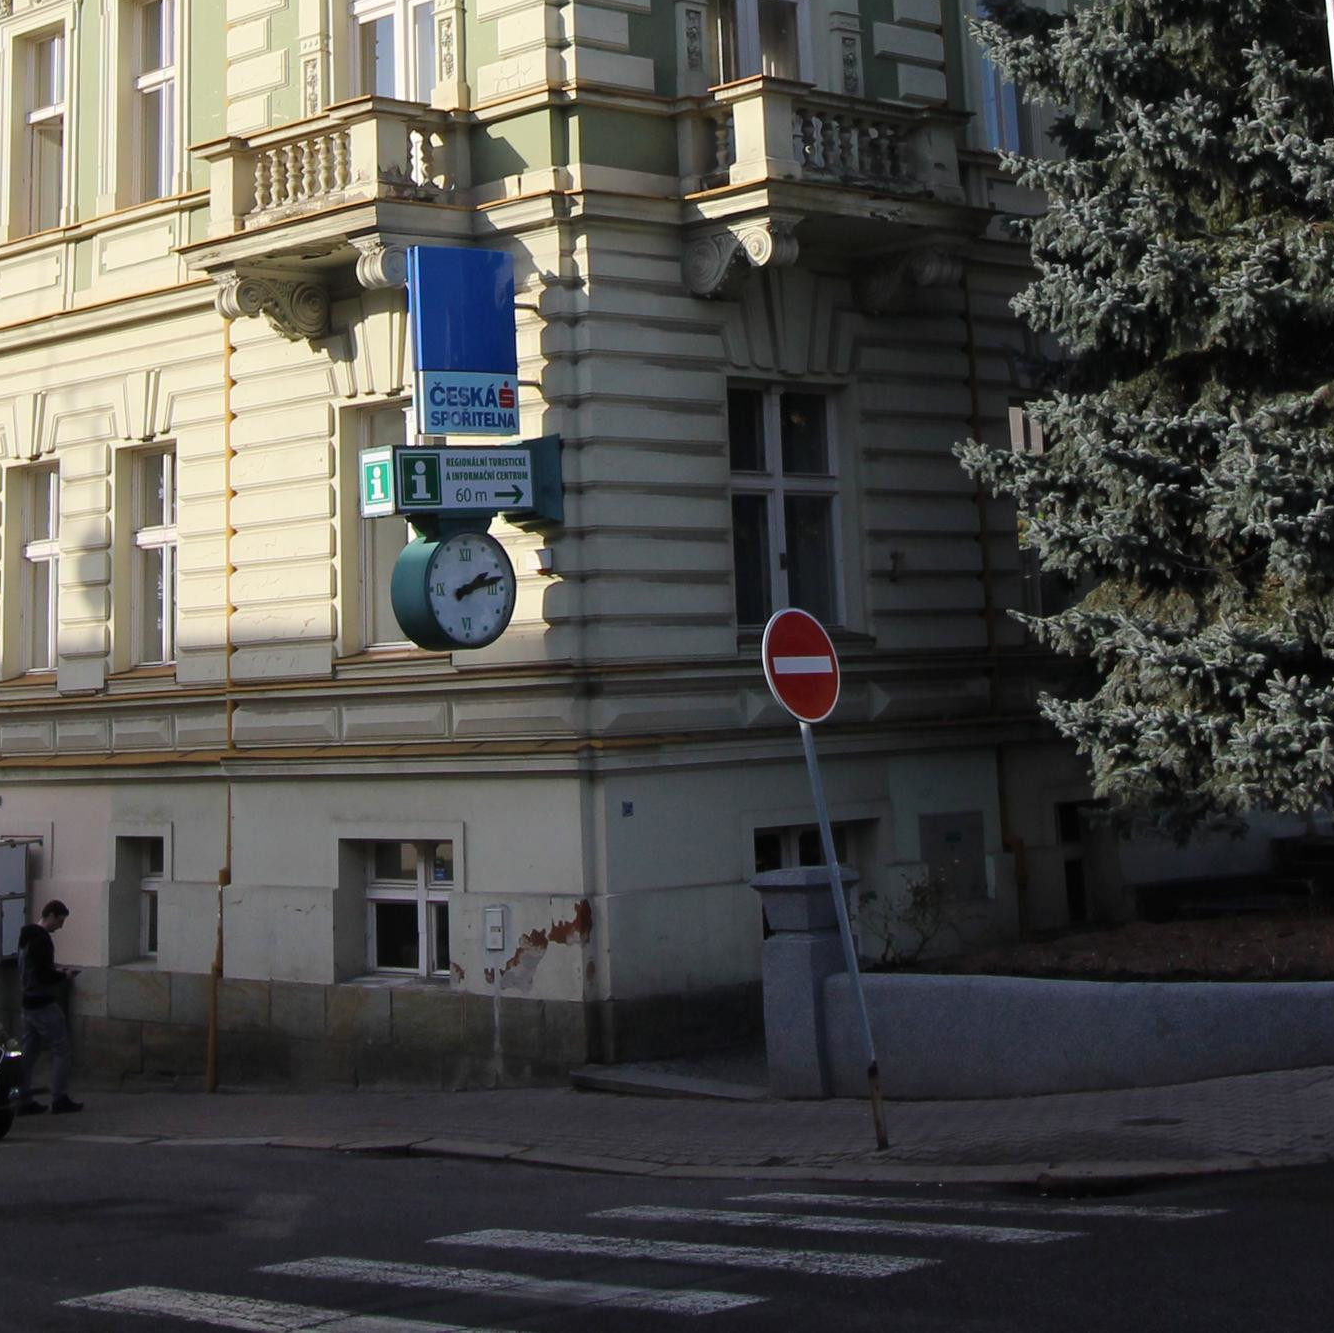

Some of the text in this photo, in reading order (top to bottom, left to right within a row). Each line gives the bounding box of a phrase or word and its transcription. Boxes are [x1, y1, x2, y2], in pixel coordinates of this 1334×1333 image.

[429, 381, 498, 408] ČESKÁ
[430, 408, 516, 428] SPOŘITELNA
[445, 456, 526, 467] REGIONÁLNÍ TURISTICKÉ
[446, 469, 528, 481] A INFORMAČNÍ CENTRUM
[455, 488, 487, 503] 60 m
[459, 548, 472, 562] XII
[462, 617, 472, 631] VI
